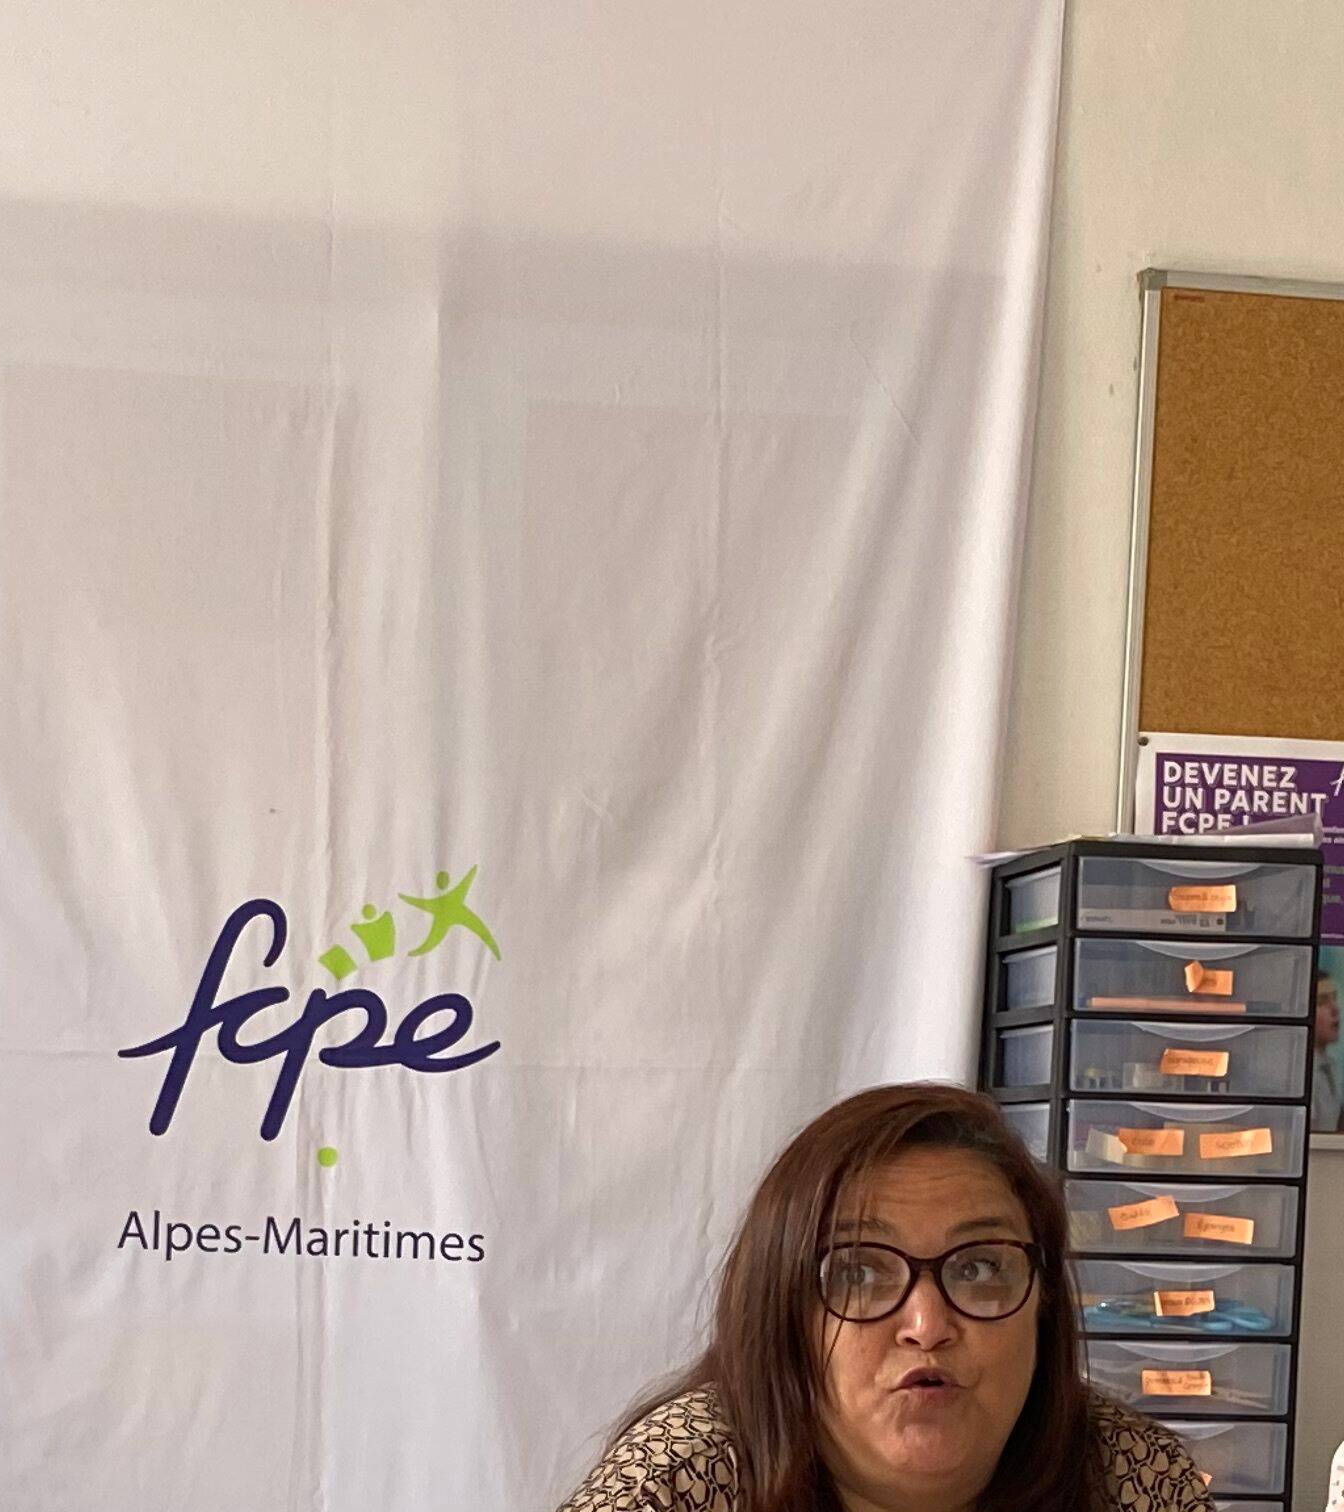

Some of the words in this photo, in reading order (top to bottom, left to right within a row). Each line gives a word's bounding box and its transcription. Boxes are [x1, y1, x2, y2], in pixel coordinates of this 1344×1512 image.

[1163, 760, 1297, 789] DEVENEZ
[1162, 786, 1204, 810] UN
[1214, 789, 1328, 815] PARENT
[117, 898, 501, 1141] fcpe
[117, 1210, 485, 1262] Alpes-Maritimes
